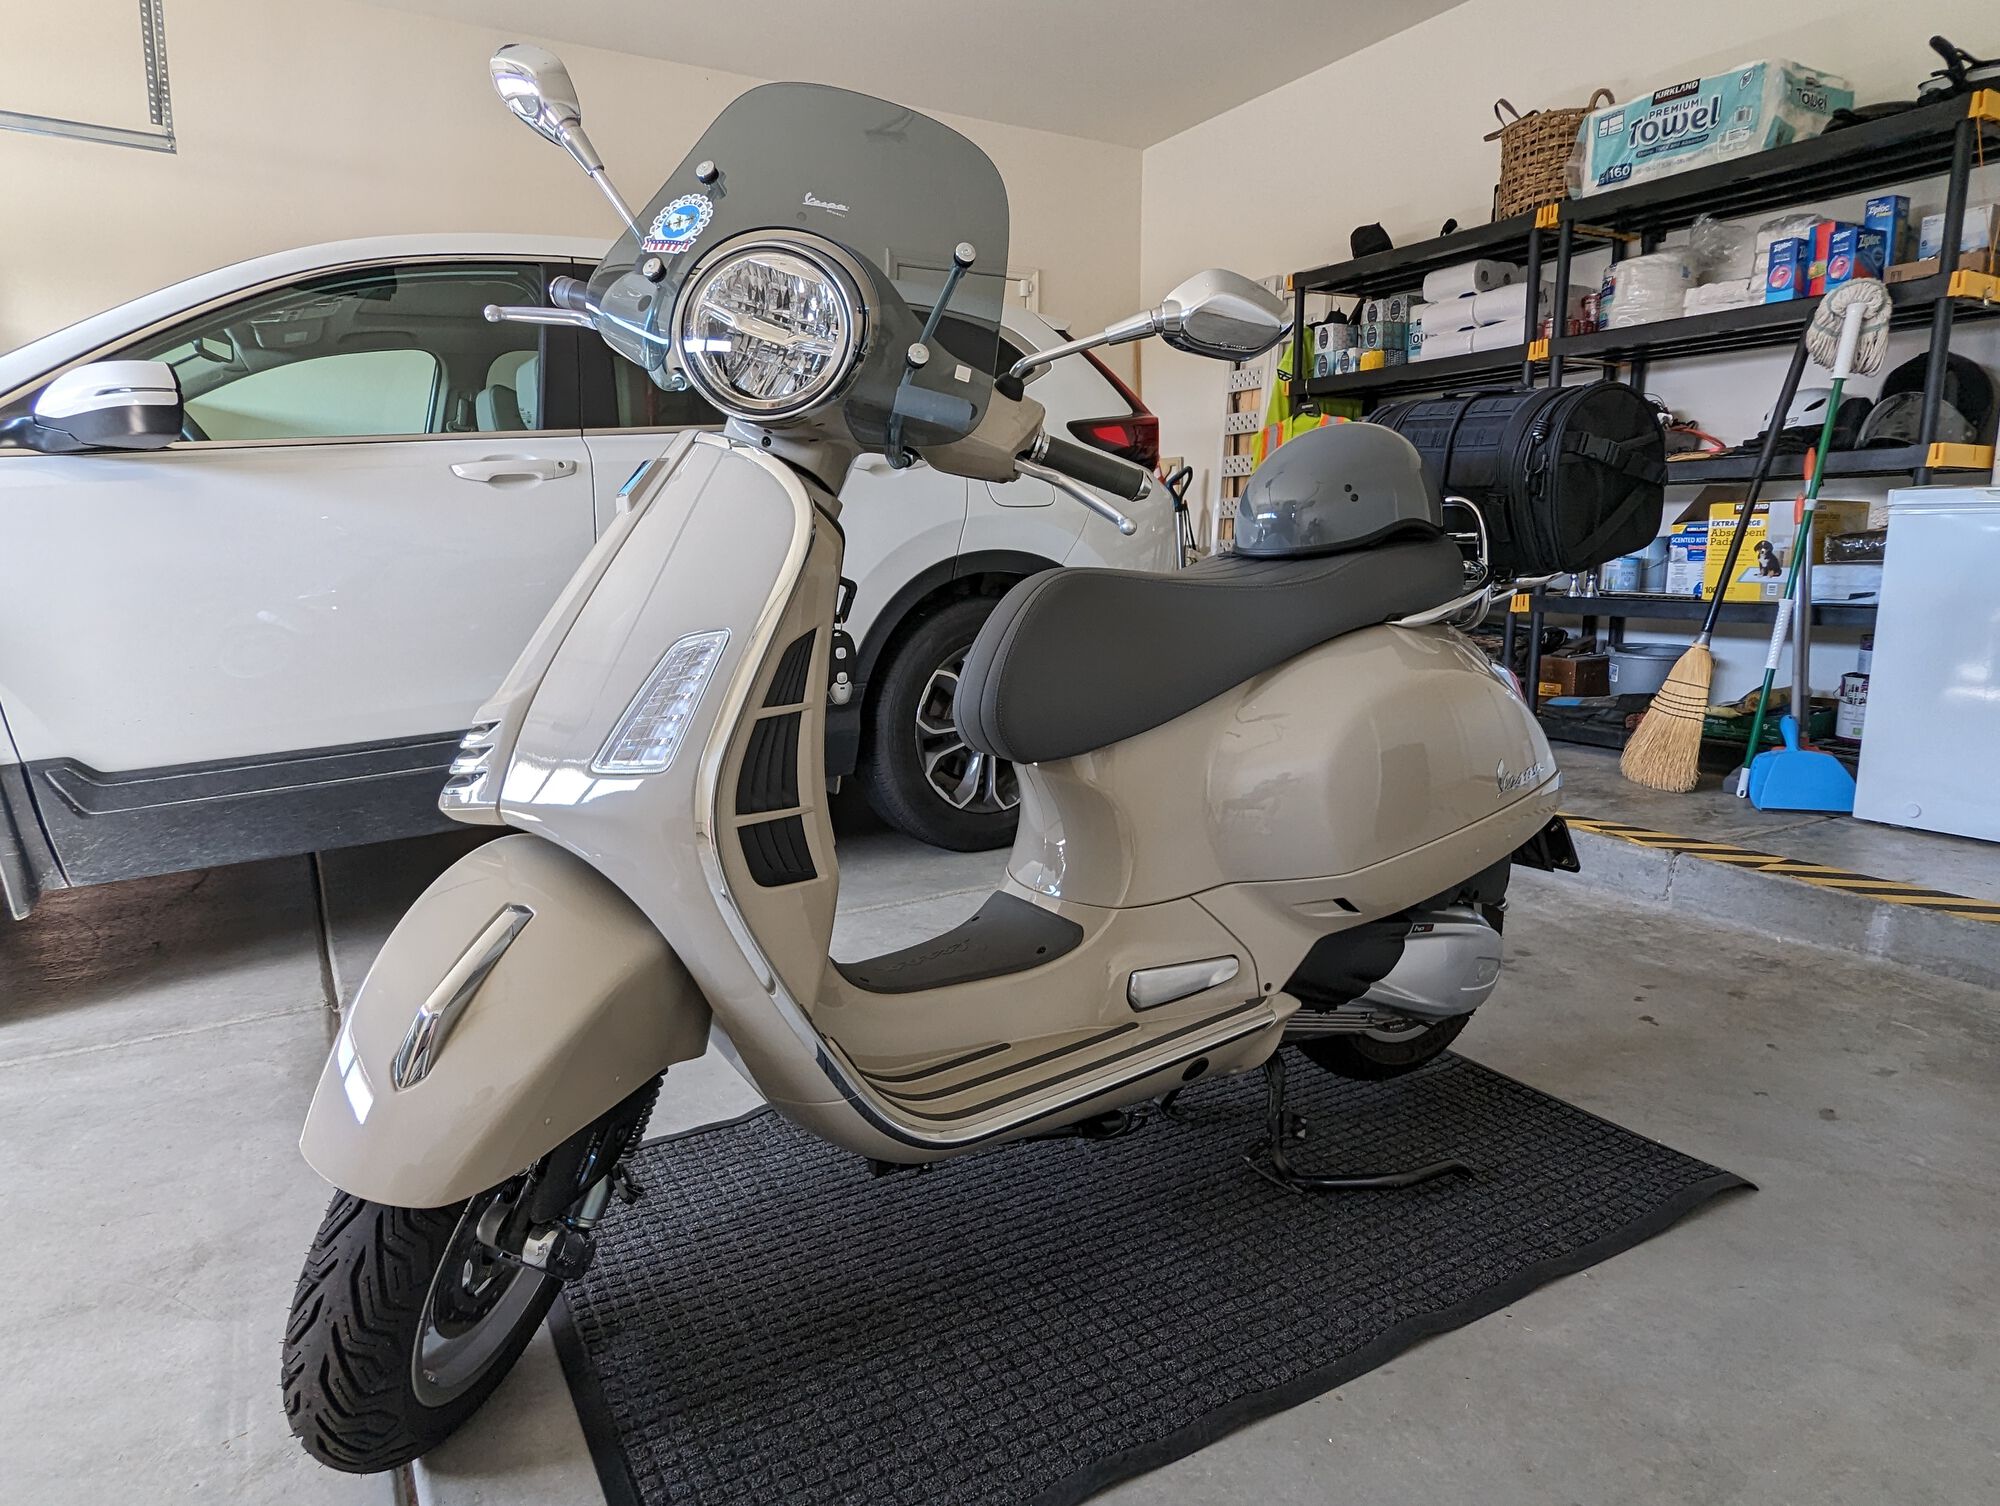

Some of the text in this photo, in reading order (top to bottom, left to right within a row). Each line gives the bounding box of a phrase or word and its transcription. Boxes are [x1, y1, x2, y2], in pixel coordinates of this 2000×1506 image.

[1654, 80, 1699, 101] KIRKLAND
[1648, 98, 1703, 120] PREMIUM
[1628, 94, 1721, 149] Towel
[1608, 166, 1631, 179] 160
[1867, 204, 1890, 217] Ziploc
[1711, 519, 1761, 527] EXTRA-RGE
